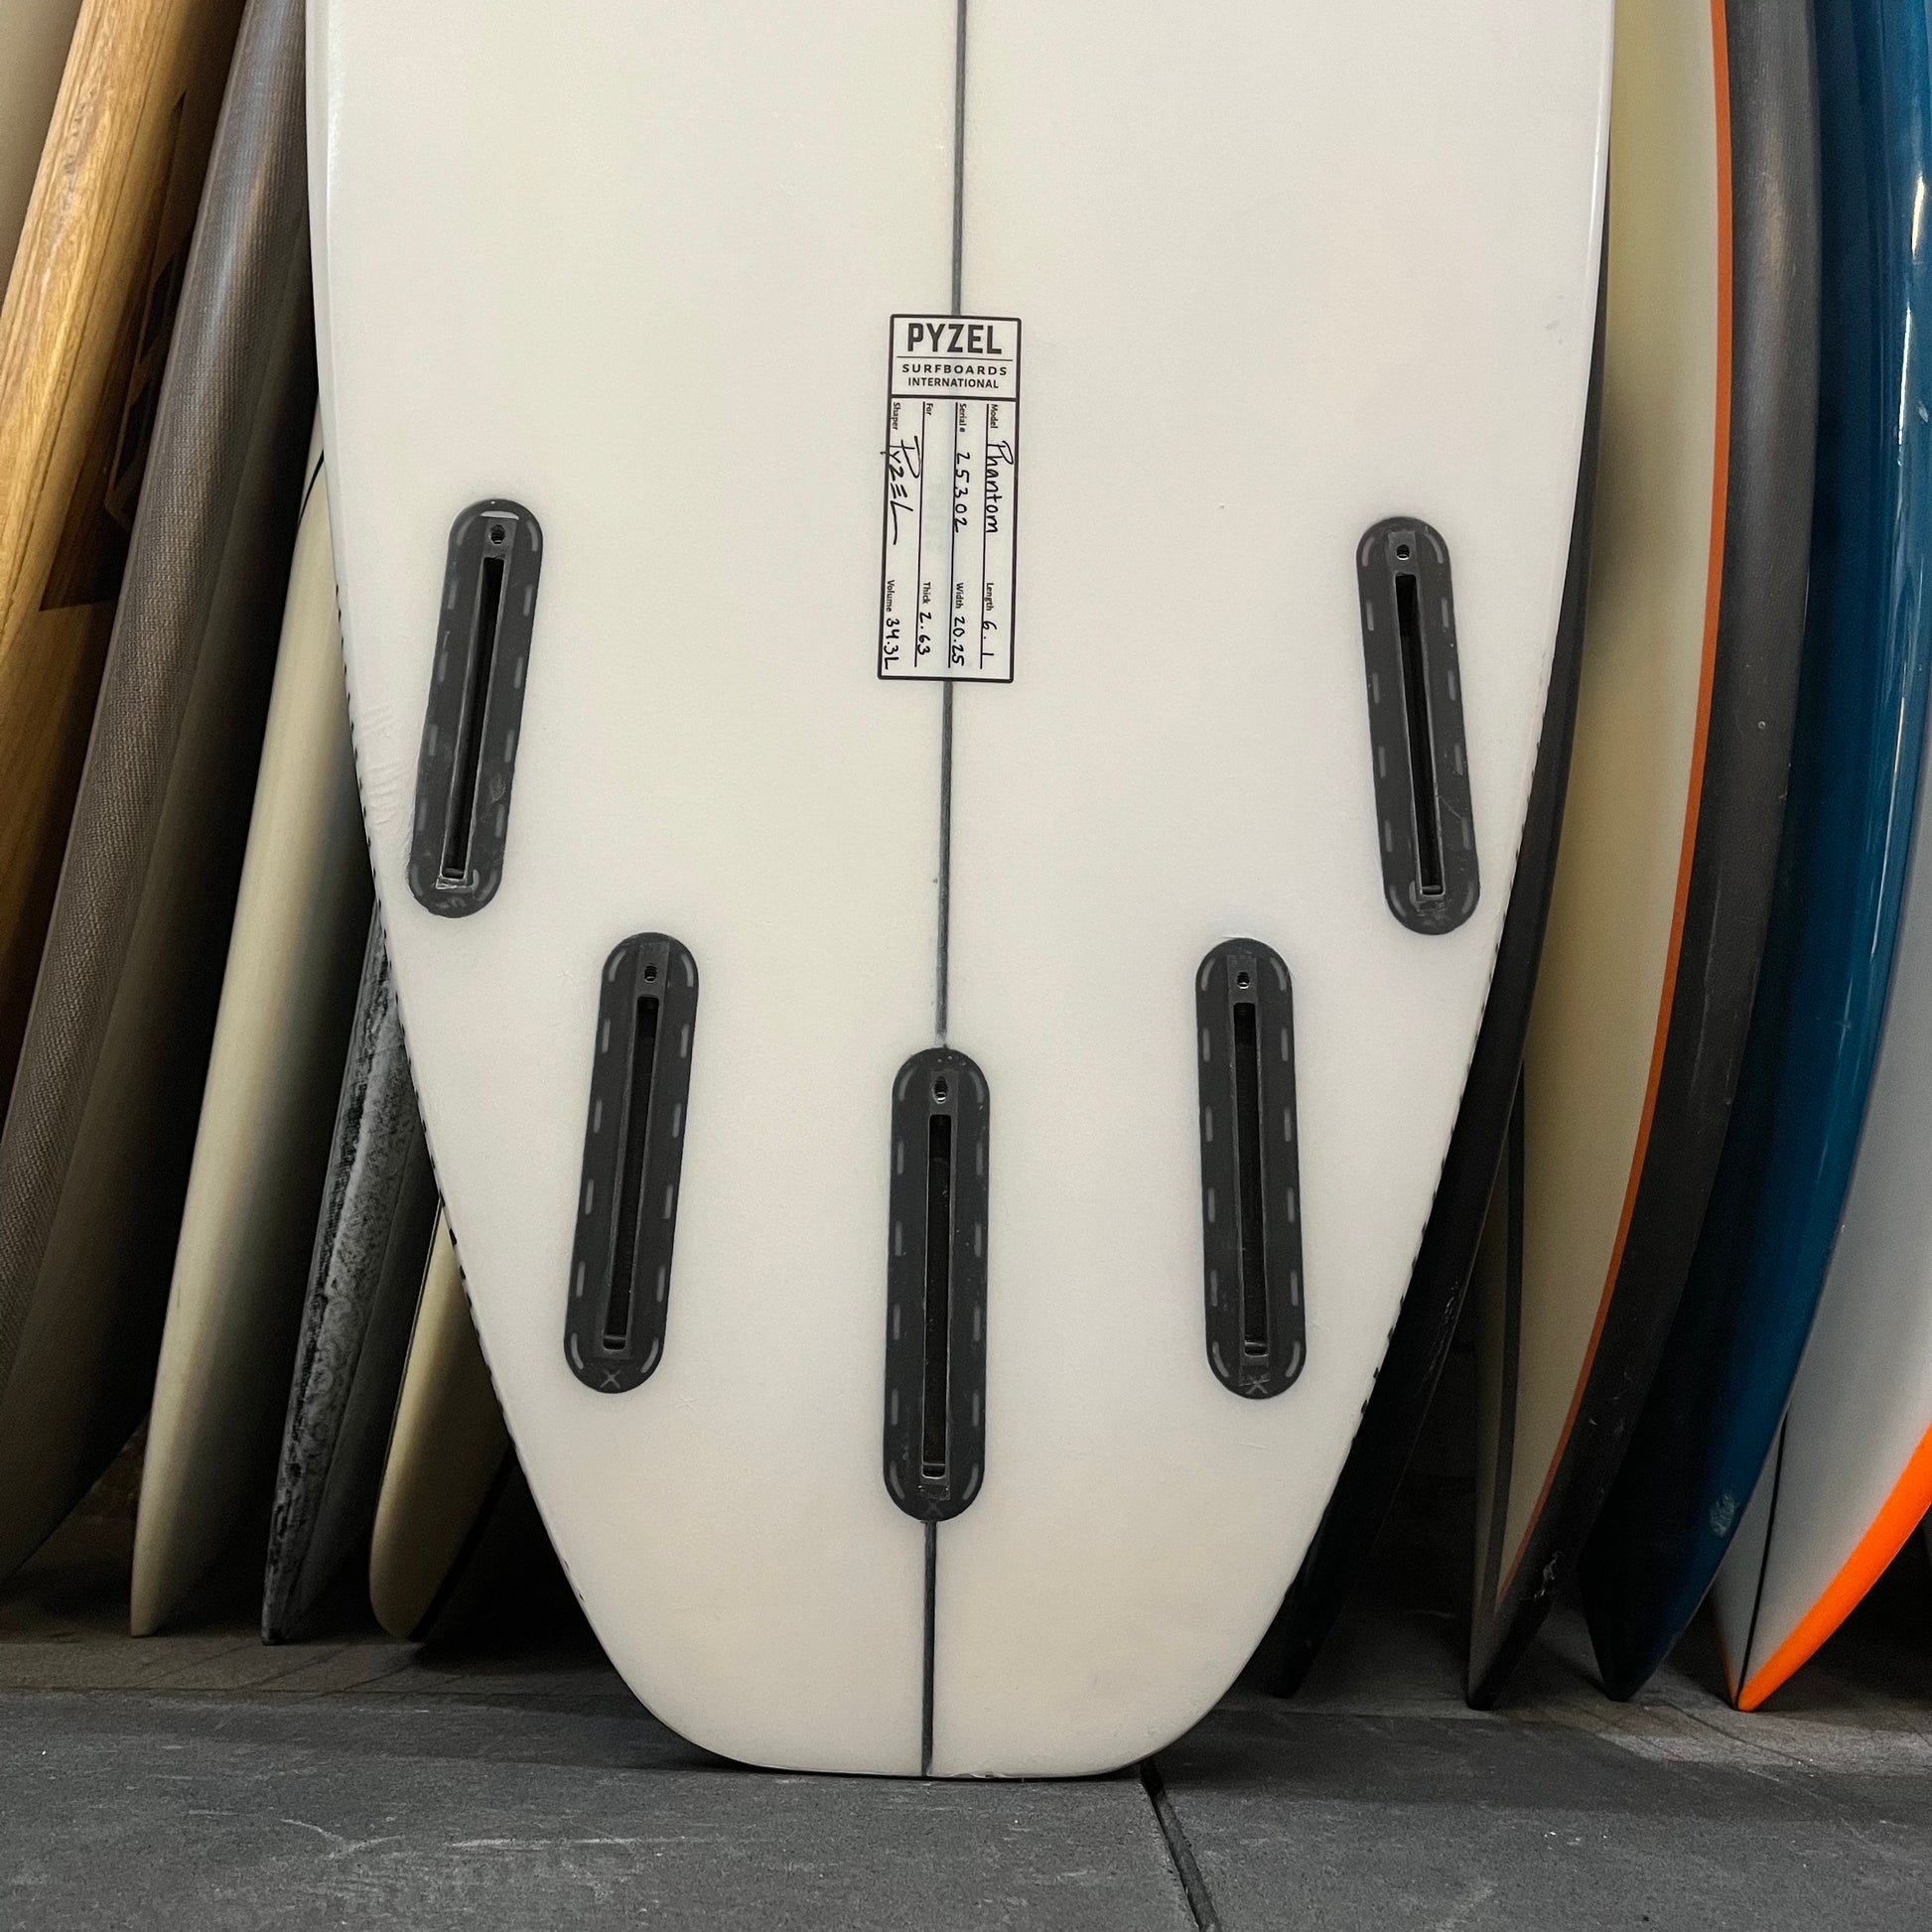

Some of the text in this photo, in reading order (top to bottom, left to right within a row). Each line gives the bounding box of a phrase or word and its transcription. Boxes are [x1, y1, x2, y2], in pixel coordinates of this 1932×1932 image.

[907, 323, 1002, 354] PYZEL
[902, 363, 1008, 376] SURFBOARDS
[908, 376, 999, 389] INTERNATIONAL
[891, 402, 900, 431] Shaper
[925, 402, 934, 416] For
[990, 404, 999, 429] Model
[953, 452, 970, 533] 25302
[985, 441, 1014, 533] Phantom
[886, 580, 895, 613] Volume
[922, 582, 931, 604] Thick
[955, 582, 964, 609] Width
[985, 582, 995, 612] Length
[884, 618, 900, 670] 34.3L
[917, 612, 932, 655] 2.63
[951, 617, 965, 667] 20.25
